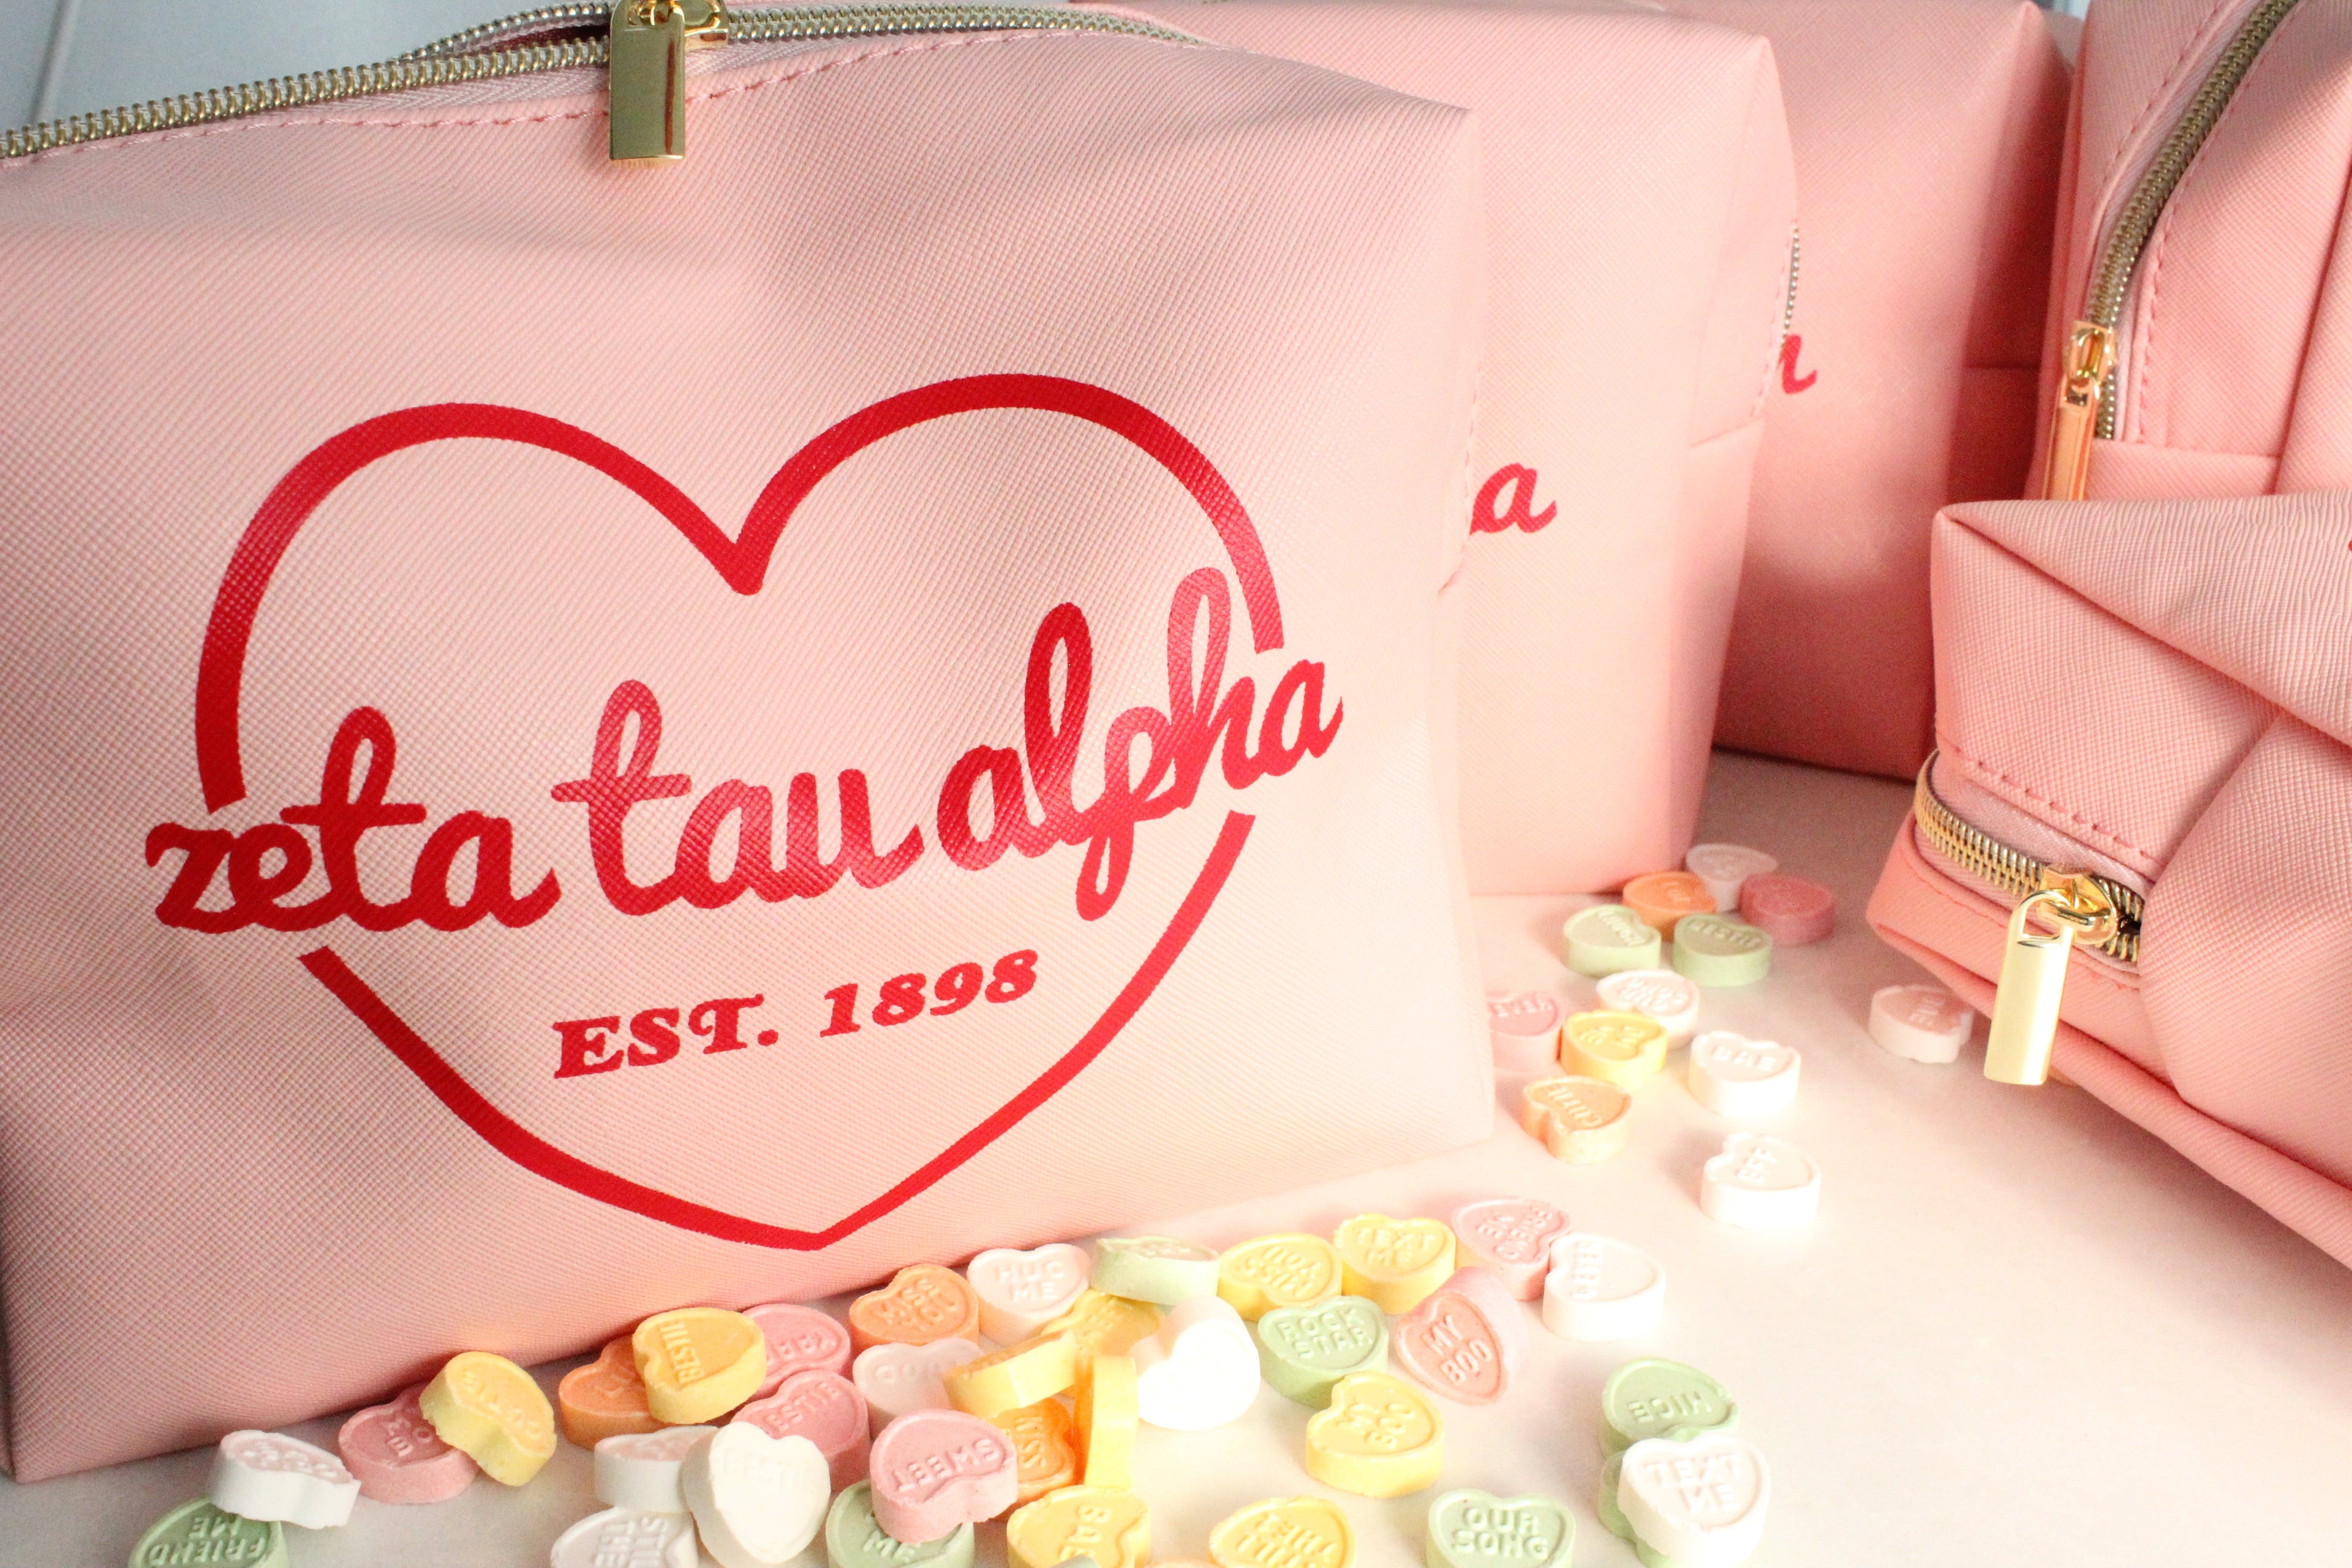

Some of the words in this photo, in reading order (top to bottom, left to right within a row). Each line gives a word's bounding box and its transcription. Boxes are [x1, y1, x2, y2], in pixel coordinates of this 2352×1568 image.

[145, 706, 562, 934] zeta
[551, 679, 925, 916] tau
[937, 568, 1343, 921] alpha
[552, 993, 779, 1079] EST.
[820, 949, 1038, 1038] 1898
[1490, 999, 1552, 1017] EVER
[1711, 1044, 1778, 1073] BAE
[1545, 1084, 1602, 1130] CUTIE
[1737, 1147, 1779, 1185] BFF
[1354, 1226, 1437, 1251] TEXT
[1366, 1246, 1414, 1265] ME
[1264, 1245, 1321, 1273] YOU
[1011, 1281, 1058, 1303] ME
[1242, 1259, 1313, 1296] MISS
[1279, 1306, 1365, 1340] ROCK
[1423, 1314, 1464, 1355] MY
[660, 1320, 704, 1385] BESTIE
[1292, 1328, 1373, 1360] STAR
[1441, 1341, 1492, 1384] BOO
[767, 1380, 842, 1434] ESTIE
[1336, 1395, 1378, 1433] MY
[1627, 1390, 1713, 1423] NICE
[1015, 1416, 1047, 1468] KISS
[1366, 1403, 1415, 1449] BOO
[890, 1437, 1000, 1493] SWEET
[1645, 1453, 1744, 1487] TEXT
[1678, 1484, 1739, 1515] ME
[189, 1515, 241, 1537] ME
[1461, 1506, 1542, 1533] OUR
[147, 1536, 272, 1568] FRIEND
[1452, 1529, 1548, 1560] SONG
